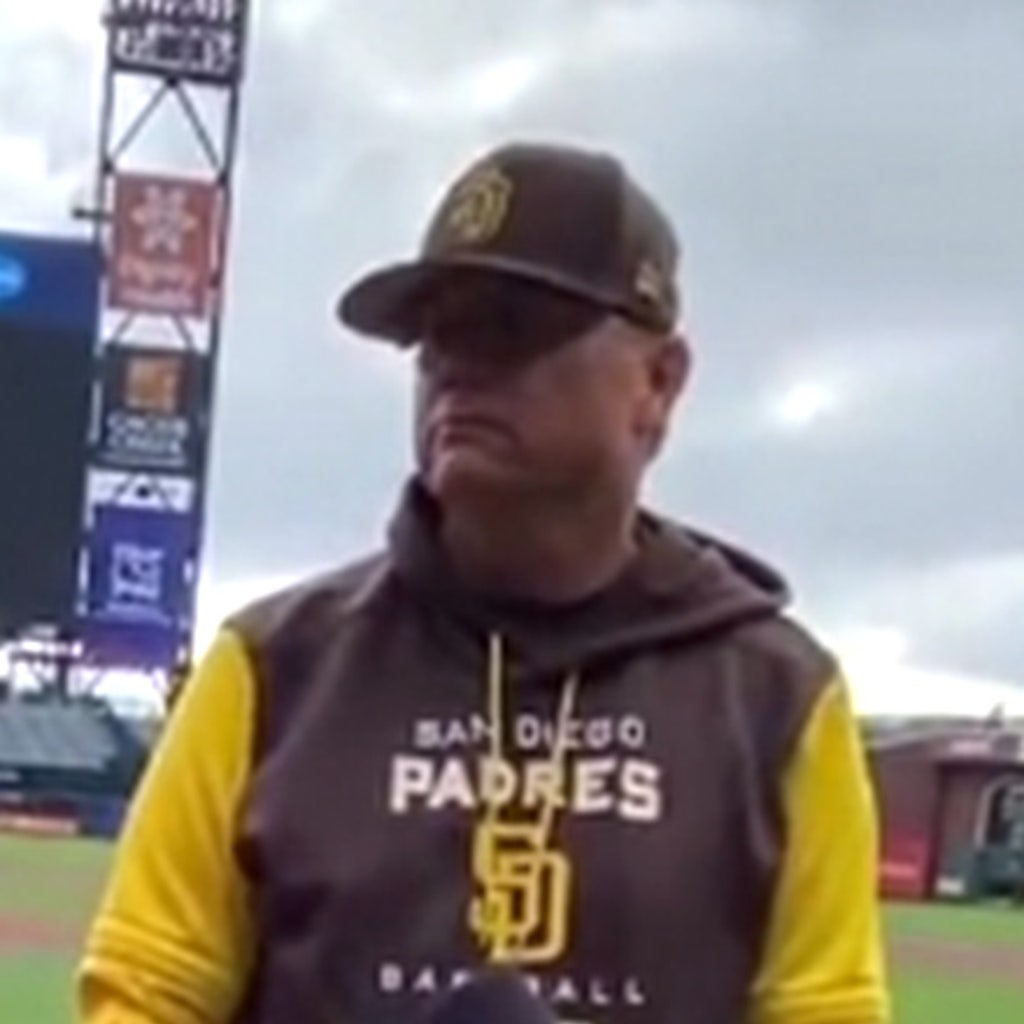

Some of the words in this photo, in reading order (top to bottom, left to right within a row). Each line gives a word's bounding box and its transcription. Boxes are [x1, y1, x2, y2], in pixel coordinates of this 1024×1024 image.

[415, 714, 494, 748] SAN
[516, 714, 647, 749] DIEGO
[389, 752, 662, 822] PADRES
[469, 820, 571, 963] SD
